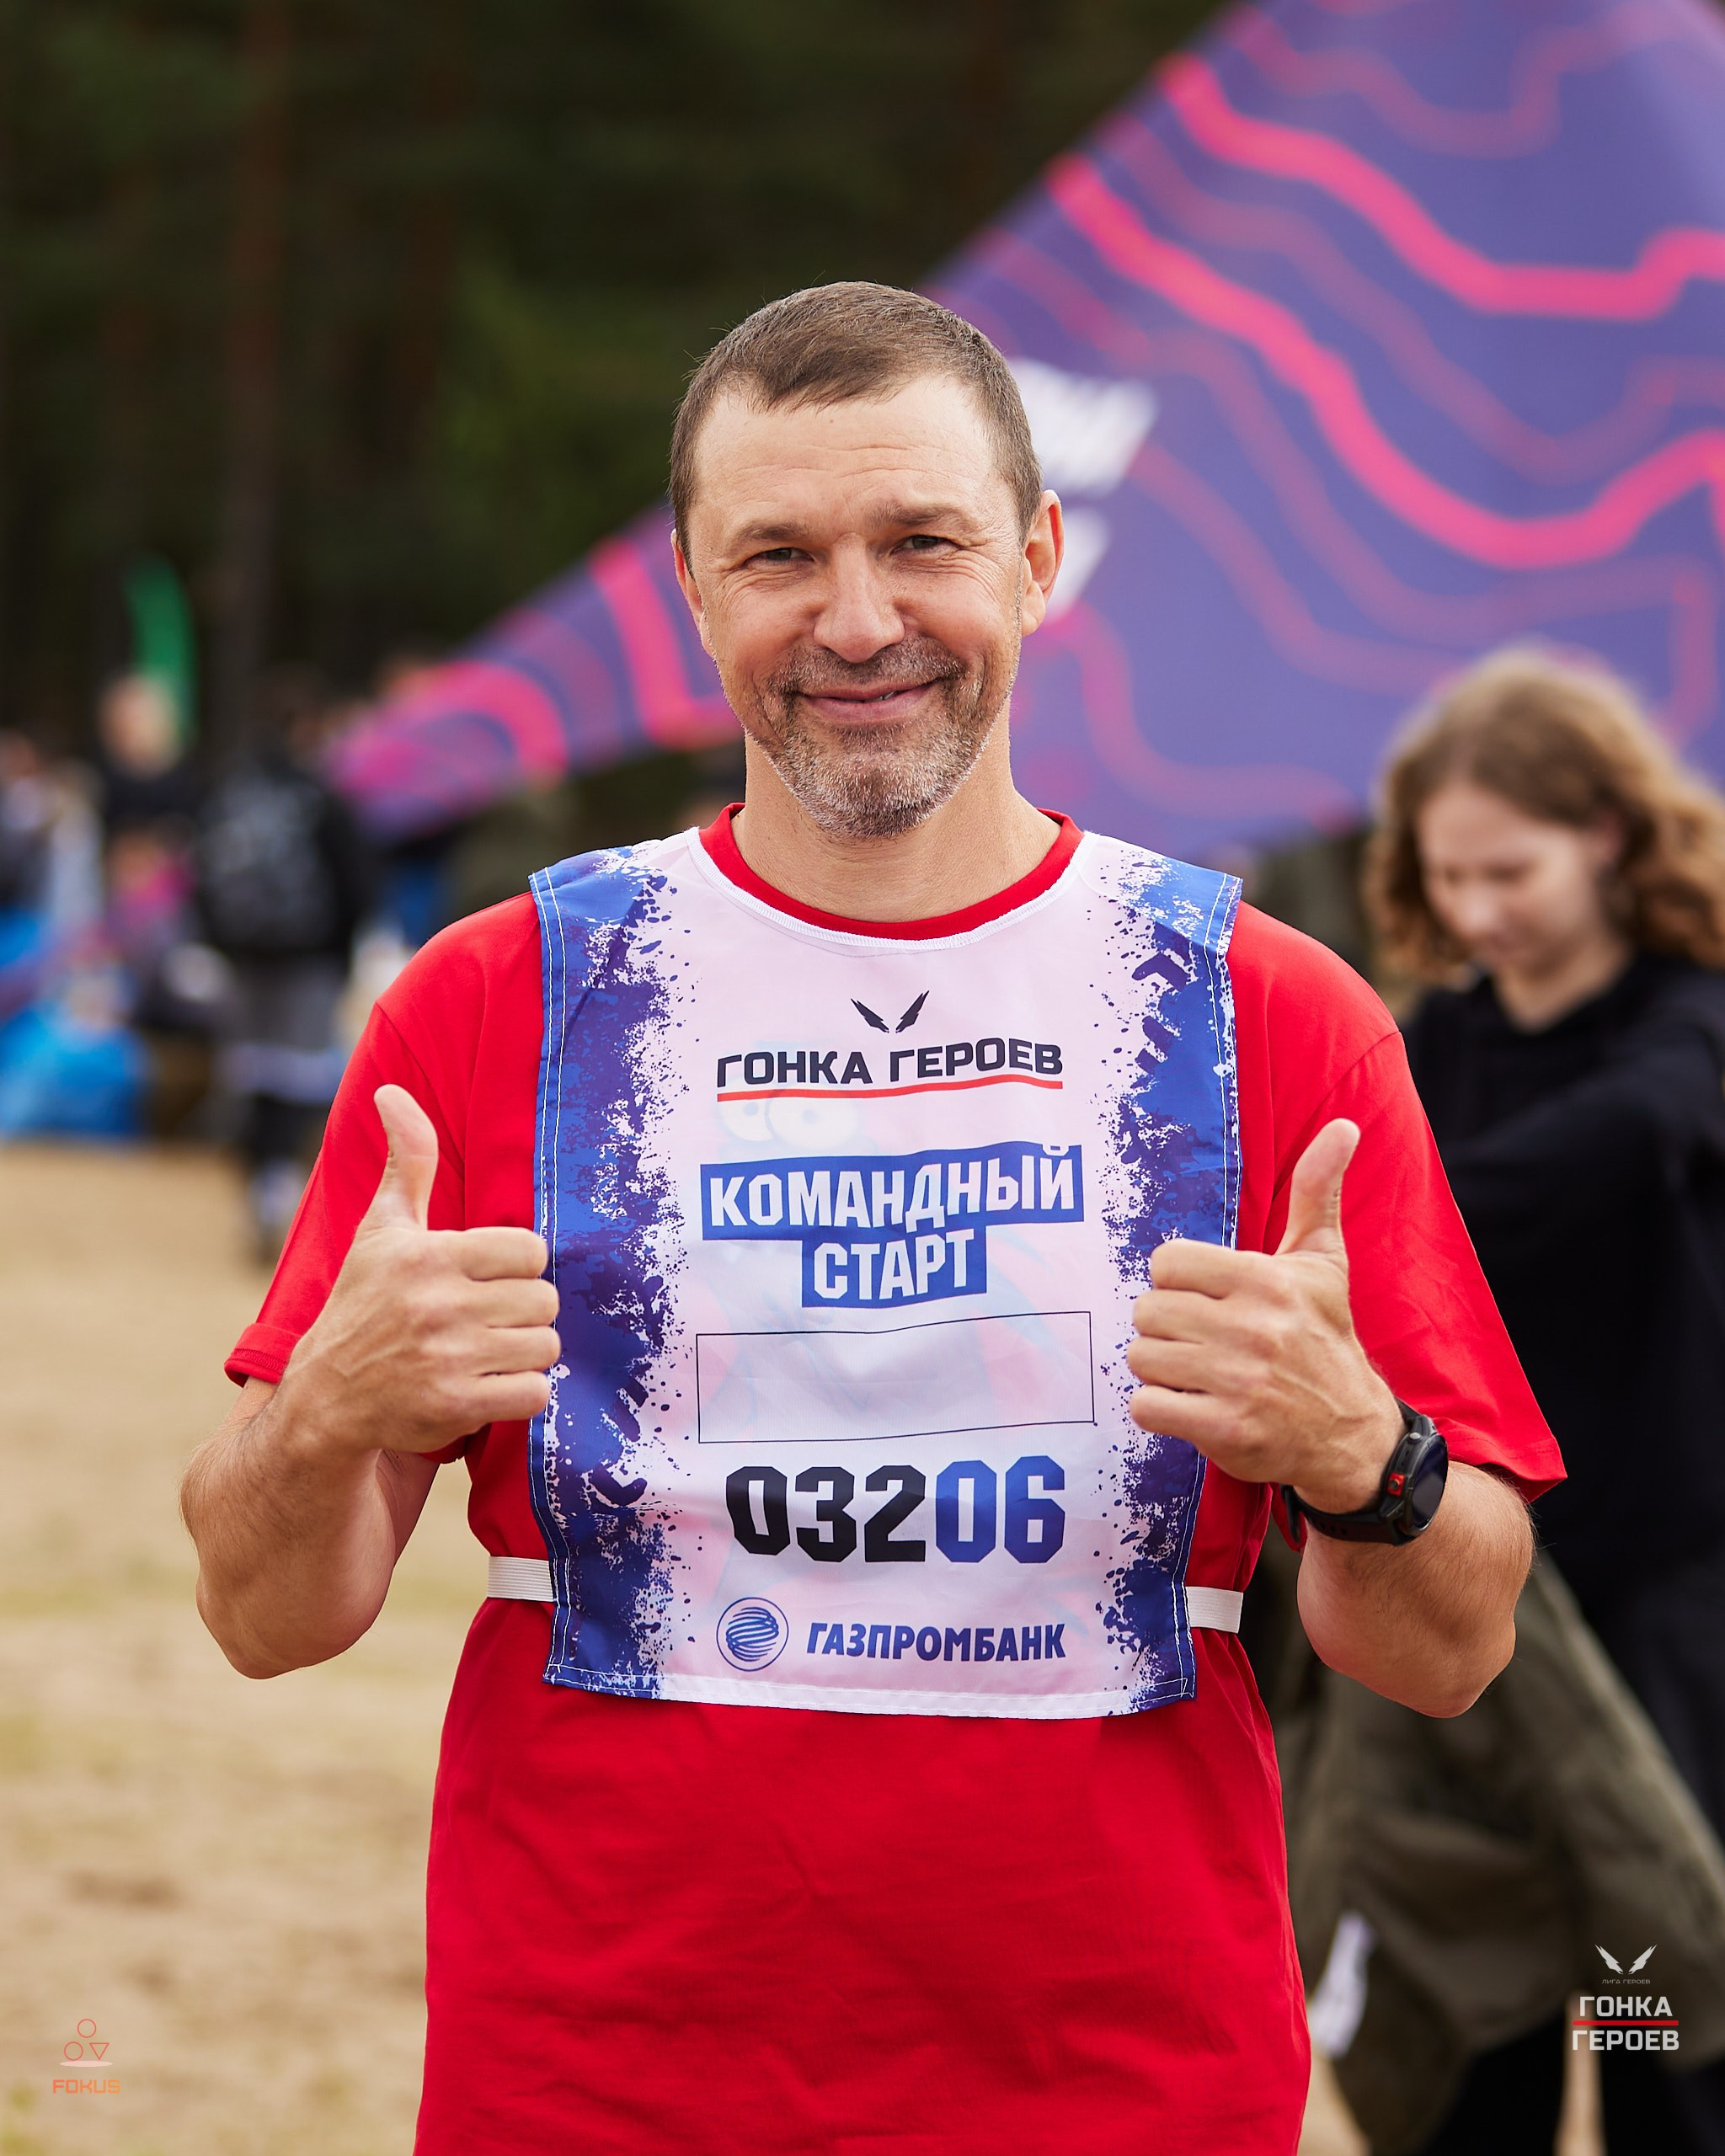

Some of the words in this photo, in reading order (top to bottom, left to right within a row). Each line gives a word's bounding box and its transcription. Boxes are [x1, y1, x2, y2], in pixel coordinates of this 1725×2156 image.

[718, 1051, 873, 1087] ГОНКА
[890, 1038, 1063, 1082] ГЕРОЕВ
[710, 1144, 1075, 1233] КОМАНДНЫЙ
[814, 1229, 975, 1300] СТАРТ
[726, 1455, 1065, 1563] 03206
[807, 1622, 1065, 1662] ГАЗПРОМБАНК
